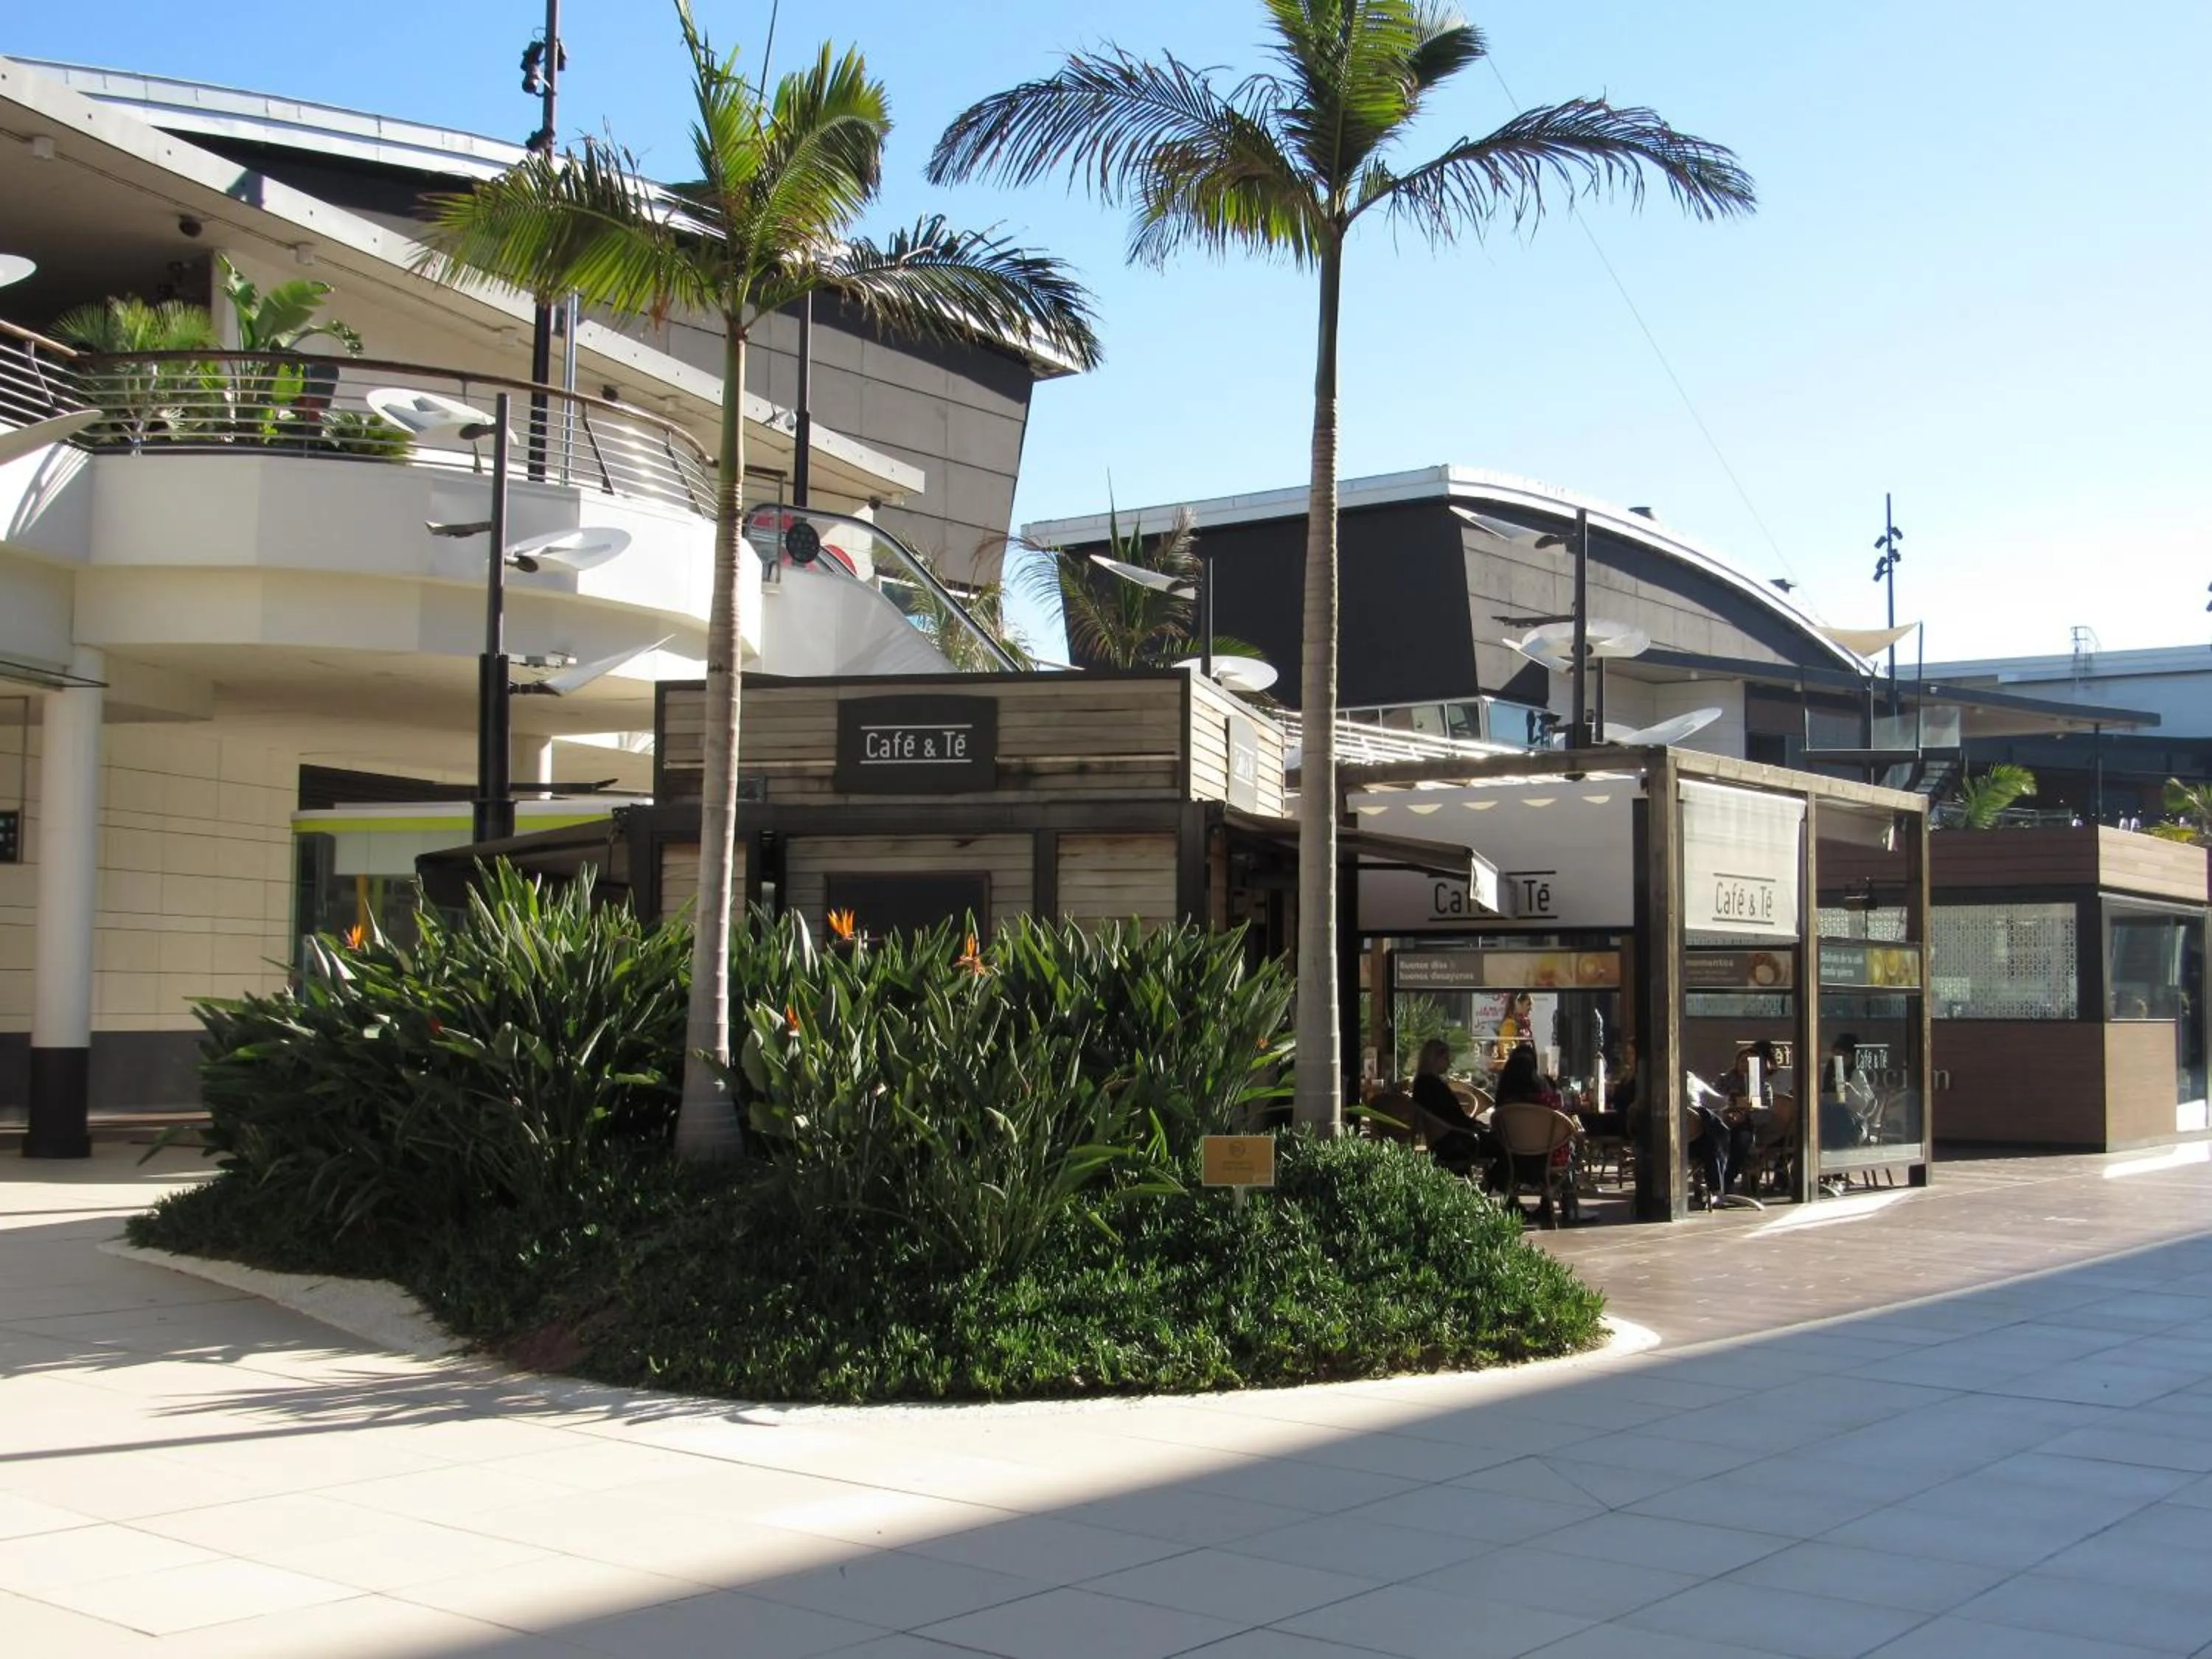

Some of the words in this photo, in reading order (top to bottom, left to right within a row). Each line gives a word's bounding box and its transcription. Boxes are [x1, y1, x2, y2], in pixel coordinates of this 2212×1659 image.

[866, 731, 915, 759] Café
[924, 738, 936, 758] &
[943, 731, 966, 758] Té
[1523, 880, 1551, 913] Té
[1715, 881, 1745, 916] Café
[1748, 893, 1756, 917] &
[1759, 886, 1773, 918] Té
